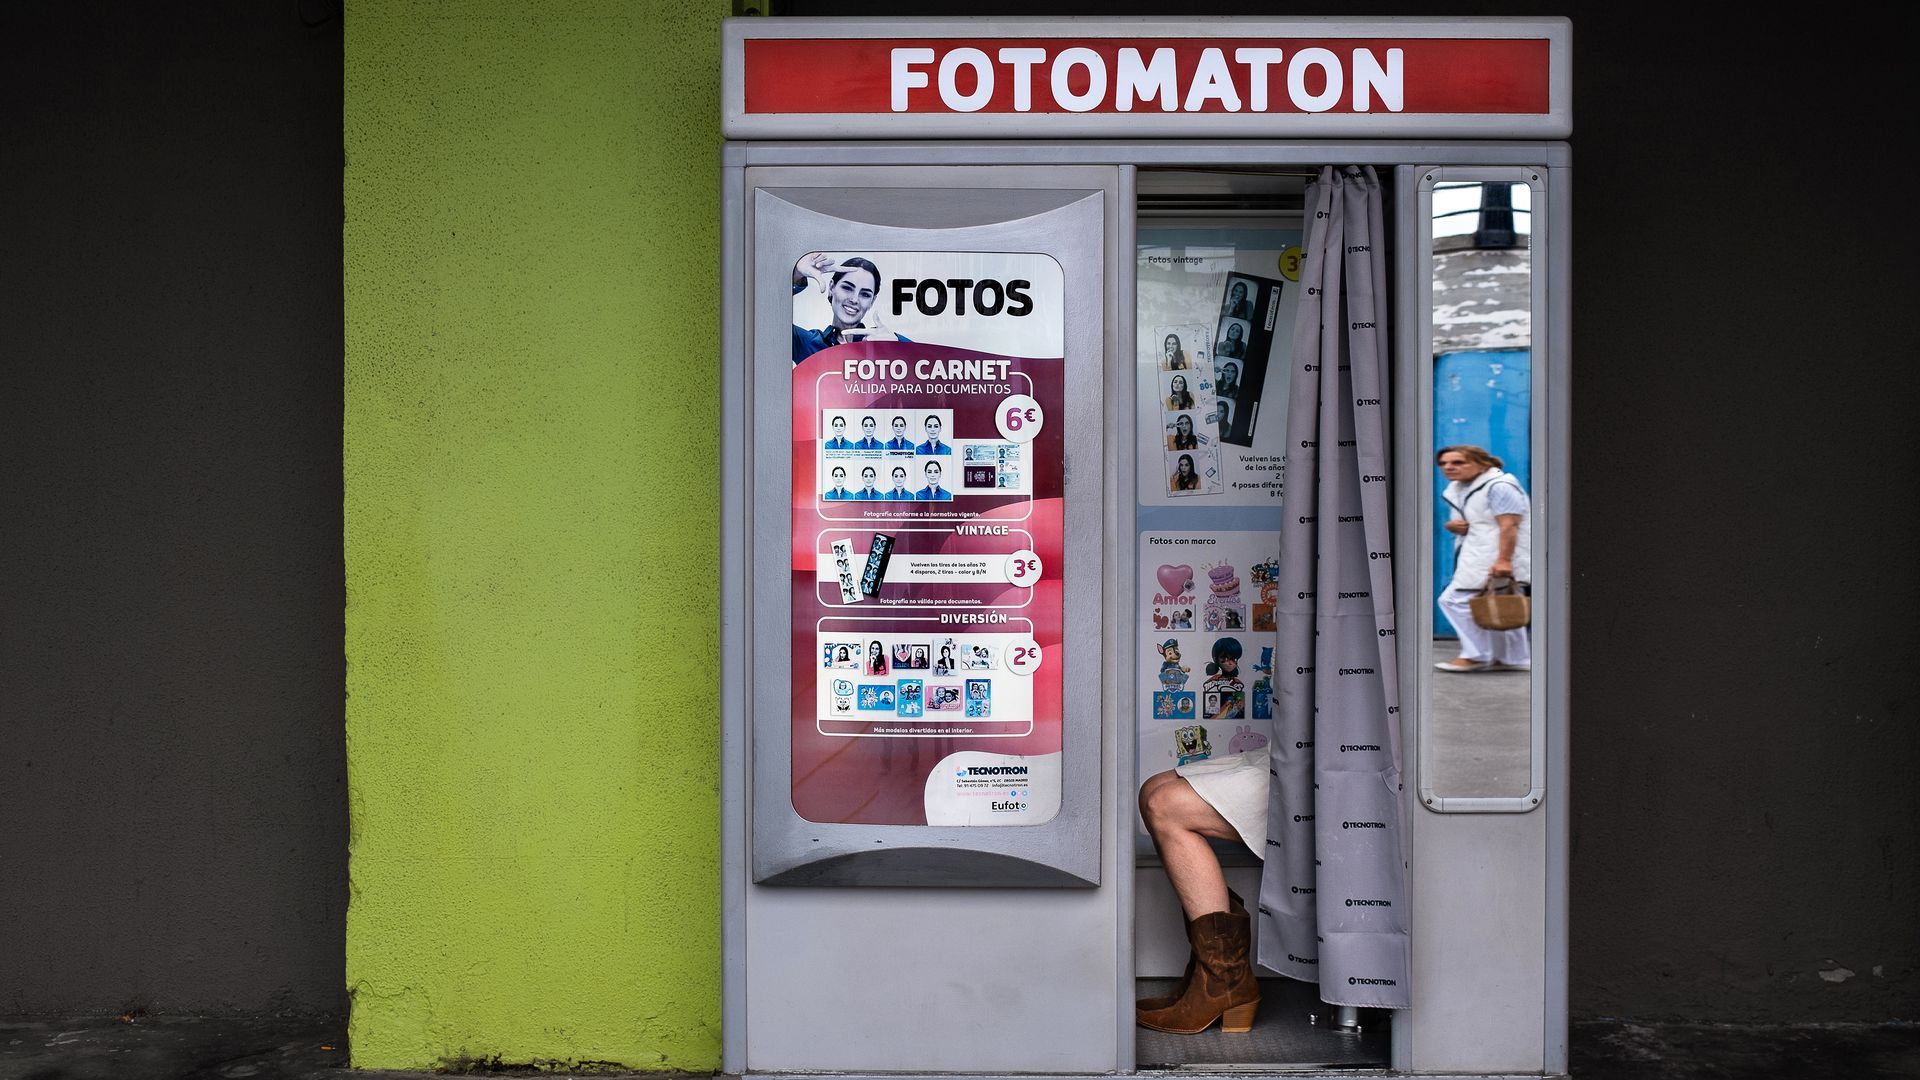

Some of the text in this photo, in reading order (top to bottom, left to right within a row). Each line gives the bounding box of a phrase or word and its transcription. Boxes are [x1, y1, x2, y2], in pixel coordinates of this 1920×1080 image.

[891, 47, 1403, 112] FOTOMATON
[1148, 256, 1203, 265] Fotos vintage
[892, 279, 1033, 317] FOTOS
[844, 359, 1011, 380] FOTO CARNET
[844, 381, 1011, 394] VÁLIDA PARA DOCUMENTOS
[1006, 407, 1036, 432] 6€
[1268, 463, 1285, 471] años
[956, 525, 1009, 536] VINTAGE
[1149, 537, 1173, 545] Fotos
[1013, 559, 1037, 578] 3€
[1152, 593, 1196, 605] Amor
[940, 610, 1007, 624] DIVERSIÓN
[1013, 647, 1037, 666] 2€
[968, 766, 1028, 775] TECNOTRON
[1356, 978, 1397, 986] TECNOTRON
